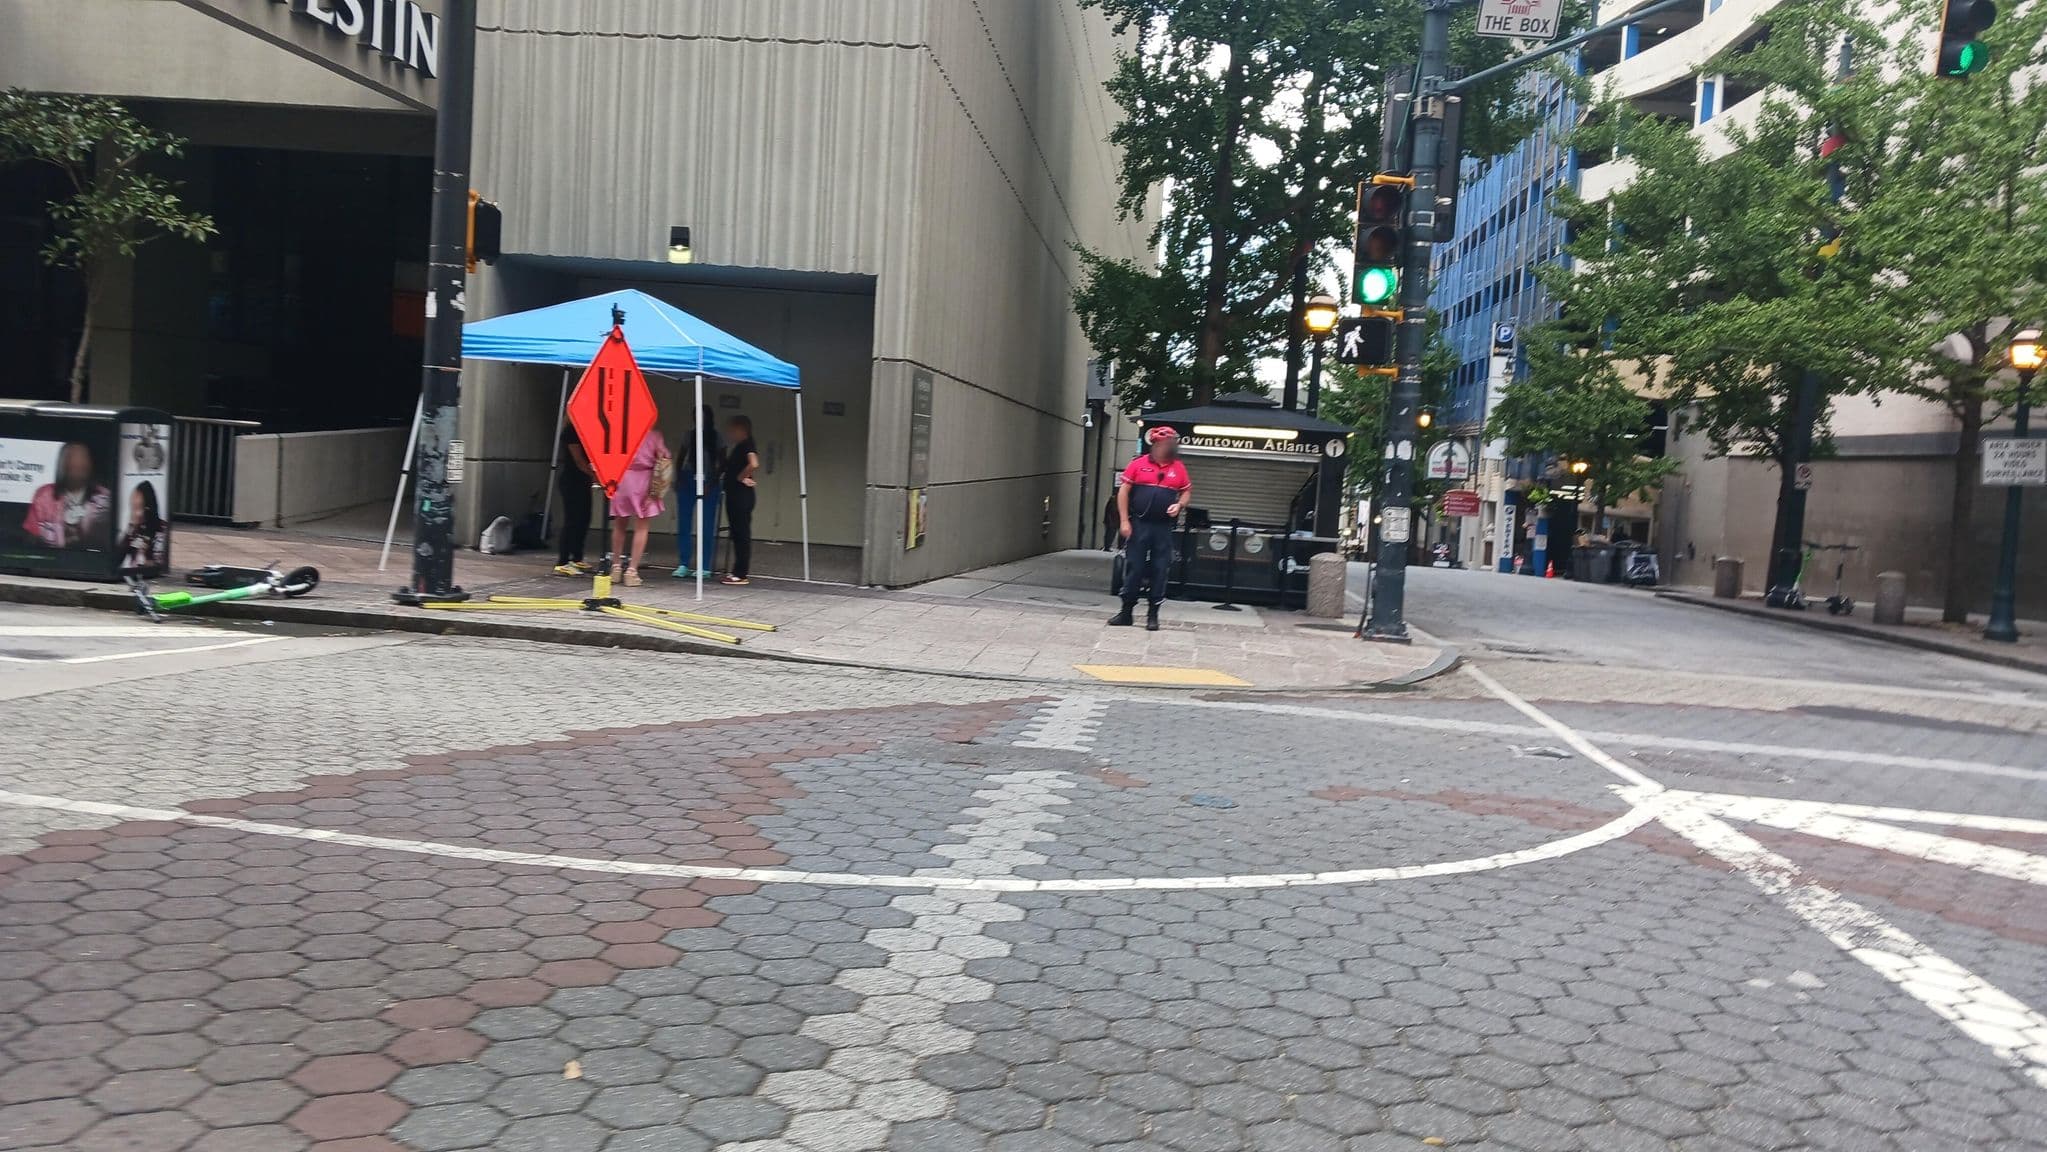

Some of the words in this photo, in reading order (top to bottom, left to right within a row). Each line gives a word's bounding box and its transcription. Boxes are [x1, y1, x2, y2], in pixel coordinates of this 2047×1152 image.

[1485, 15, 1513, 31] THE
[1520, 17, 1551, 33] BOX
[1176, 434, 1254, 450] owntown
[1263, 438, 1320, 454] Atlanta
